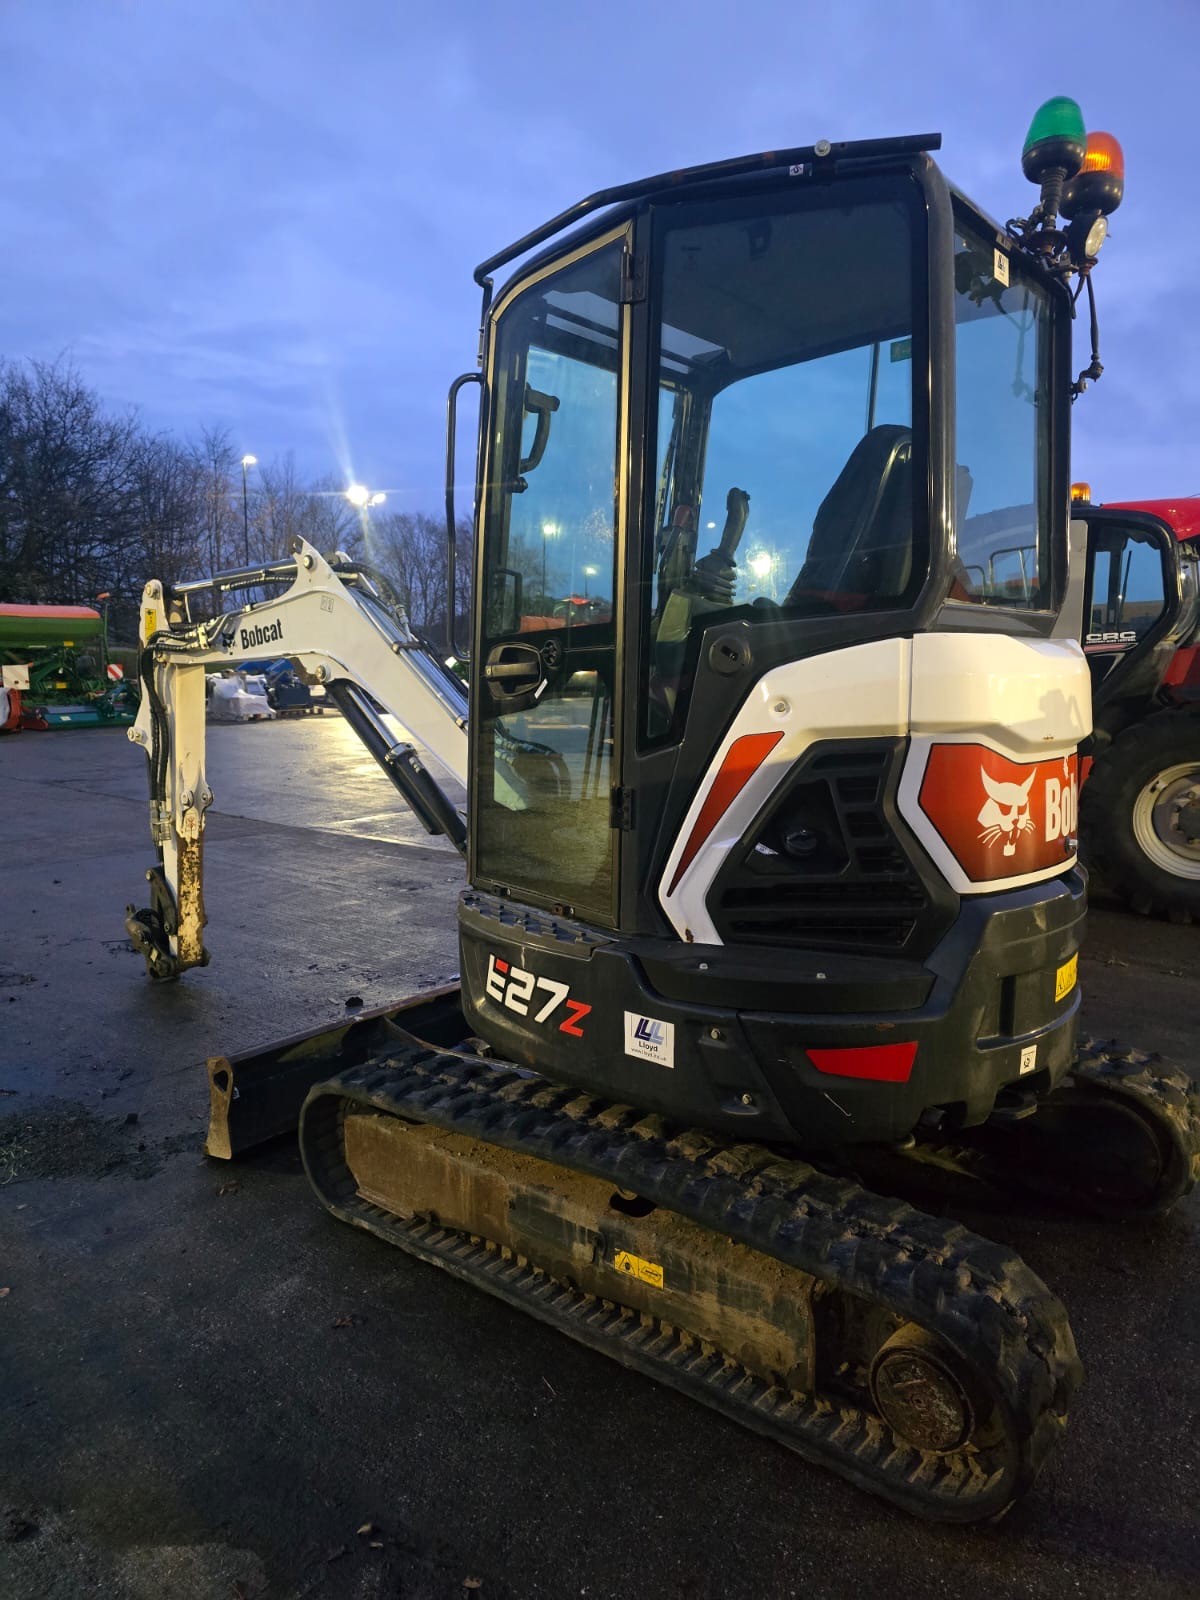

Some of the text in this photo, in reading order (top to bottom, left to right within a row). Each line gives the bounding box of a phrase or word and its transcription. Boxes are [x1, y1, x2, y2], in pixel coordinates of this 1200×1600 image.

[240, 618, 283, 650] Bobcat
[1086, 631, 1136, 641] CRC
[638, 1040, 659, 1052] Lloyd
